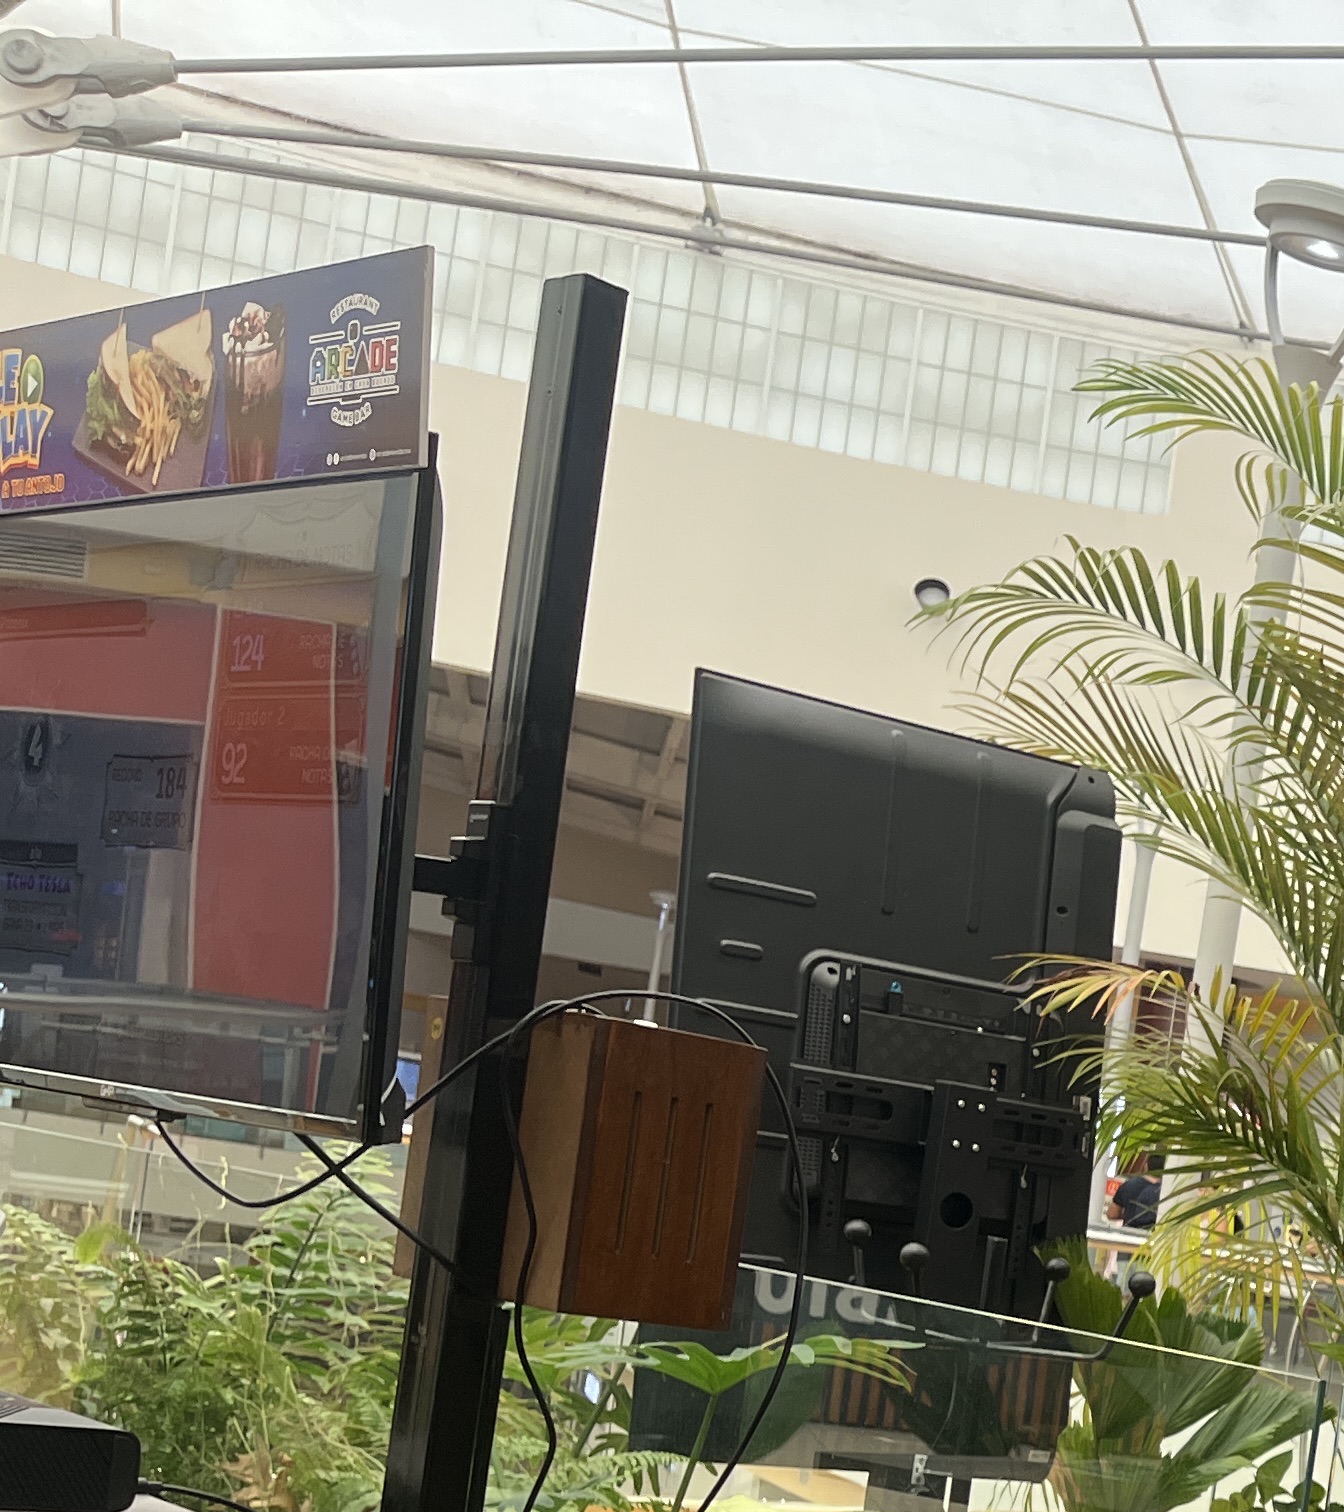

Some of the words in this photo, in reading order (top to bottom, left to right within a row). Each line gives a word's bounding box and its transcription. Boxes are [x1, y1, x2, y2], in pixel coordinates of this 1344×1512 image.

[331, 406, 354, 426] GAME
[354, 402, 372, 425] BAR
[2, 480, 9, 498] A
[12, 478, 25, 497] TU
[25, 474, 65, 496] ANTOJO
[231, 635, 264, 672] 124
[221, 742, 248, 785] 92
[155, 767, 186, 799] 184
